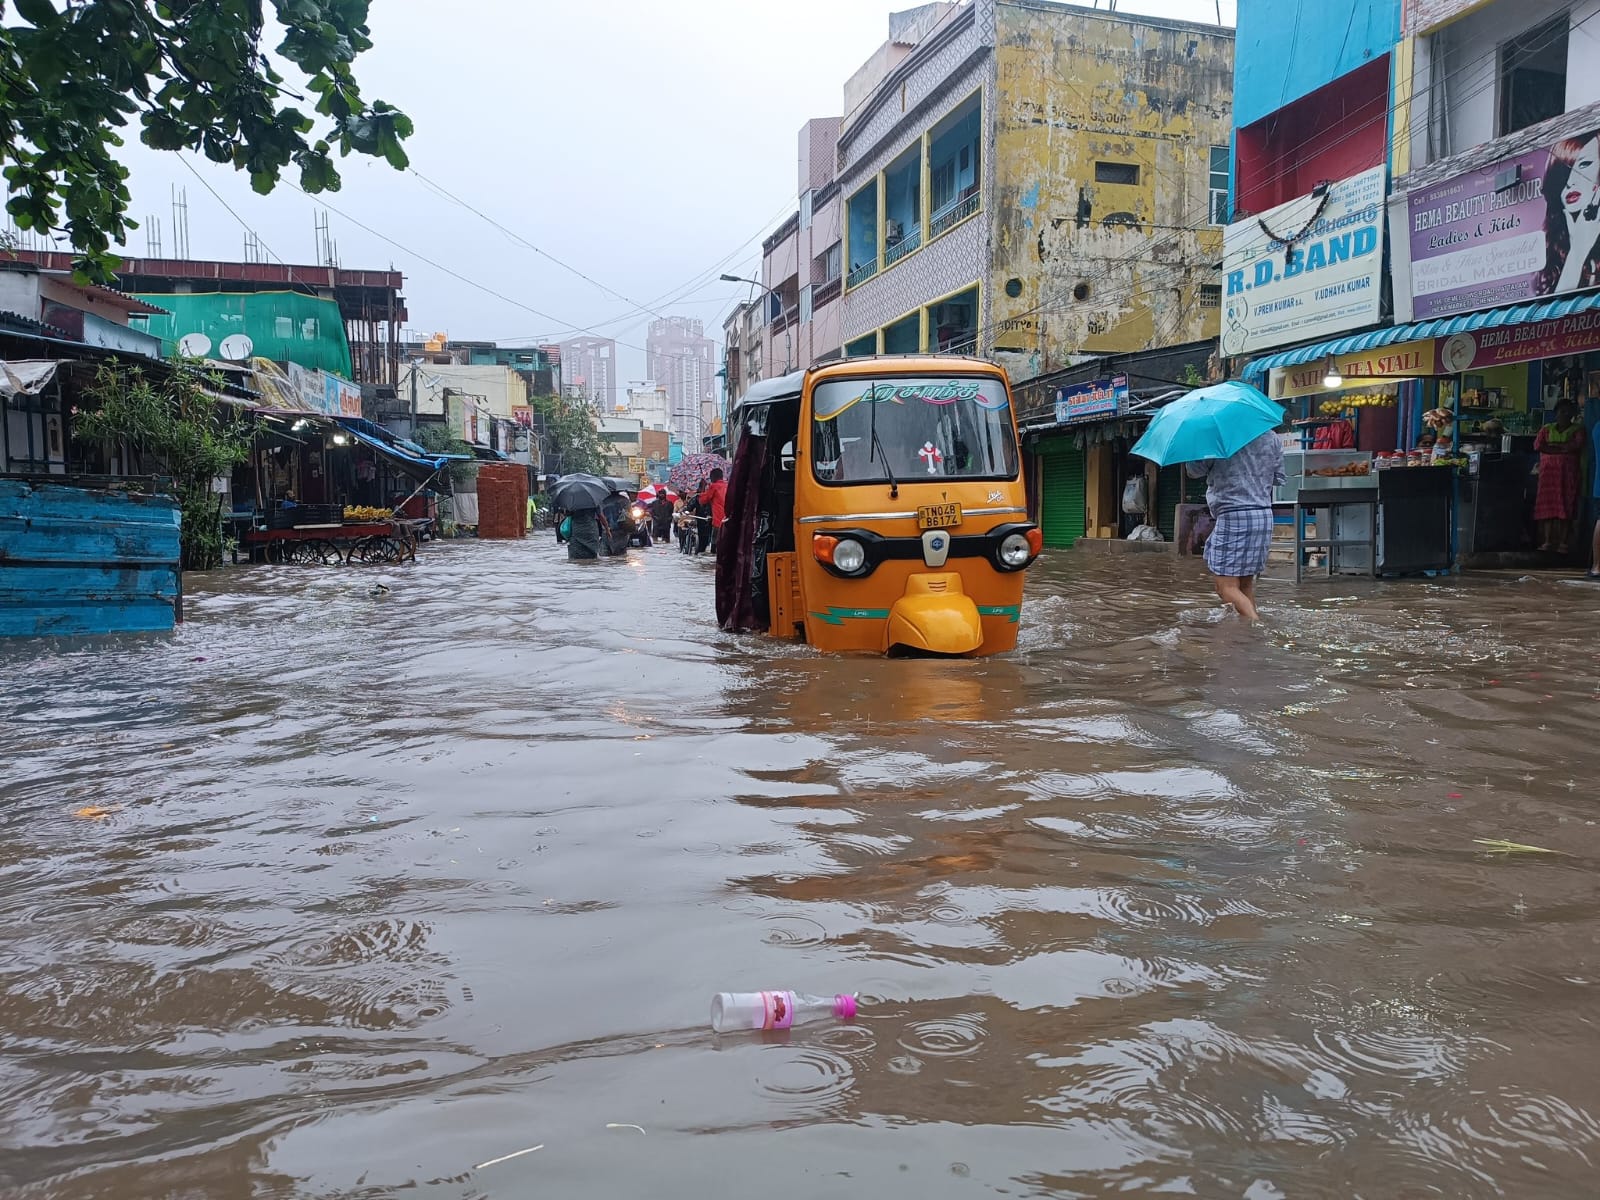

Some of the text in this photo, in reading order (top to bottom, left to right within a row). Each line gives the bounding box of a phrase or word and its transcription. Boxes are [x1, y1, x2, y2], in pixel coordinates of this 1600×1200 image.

[1414, 177, 1543, 232] HEMA BEAUTY PARLOUR
[1427, 213, 1521, 251] Ladies & Kids
[1346, 276, 1371, 293] KUMAR
[1417, 257, 1538, 292] BRIDAL MAKEUP
[1274, 298, 1295, 313] KUMAR
[1480, 331, 1510, 348] HEMA
[1513, 320, 1561, 342] BEAUTY
[1494, 344, 1543, 360] Ladies
[1562, 332, 1600, 349] Kids
[1344, 360, 1374, 380] TEA
[1377, 351, 1425, 375] STALL
[925, 505, 956, 517] TN04B
